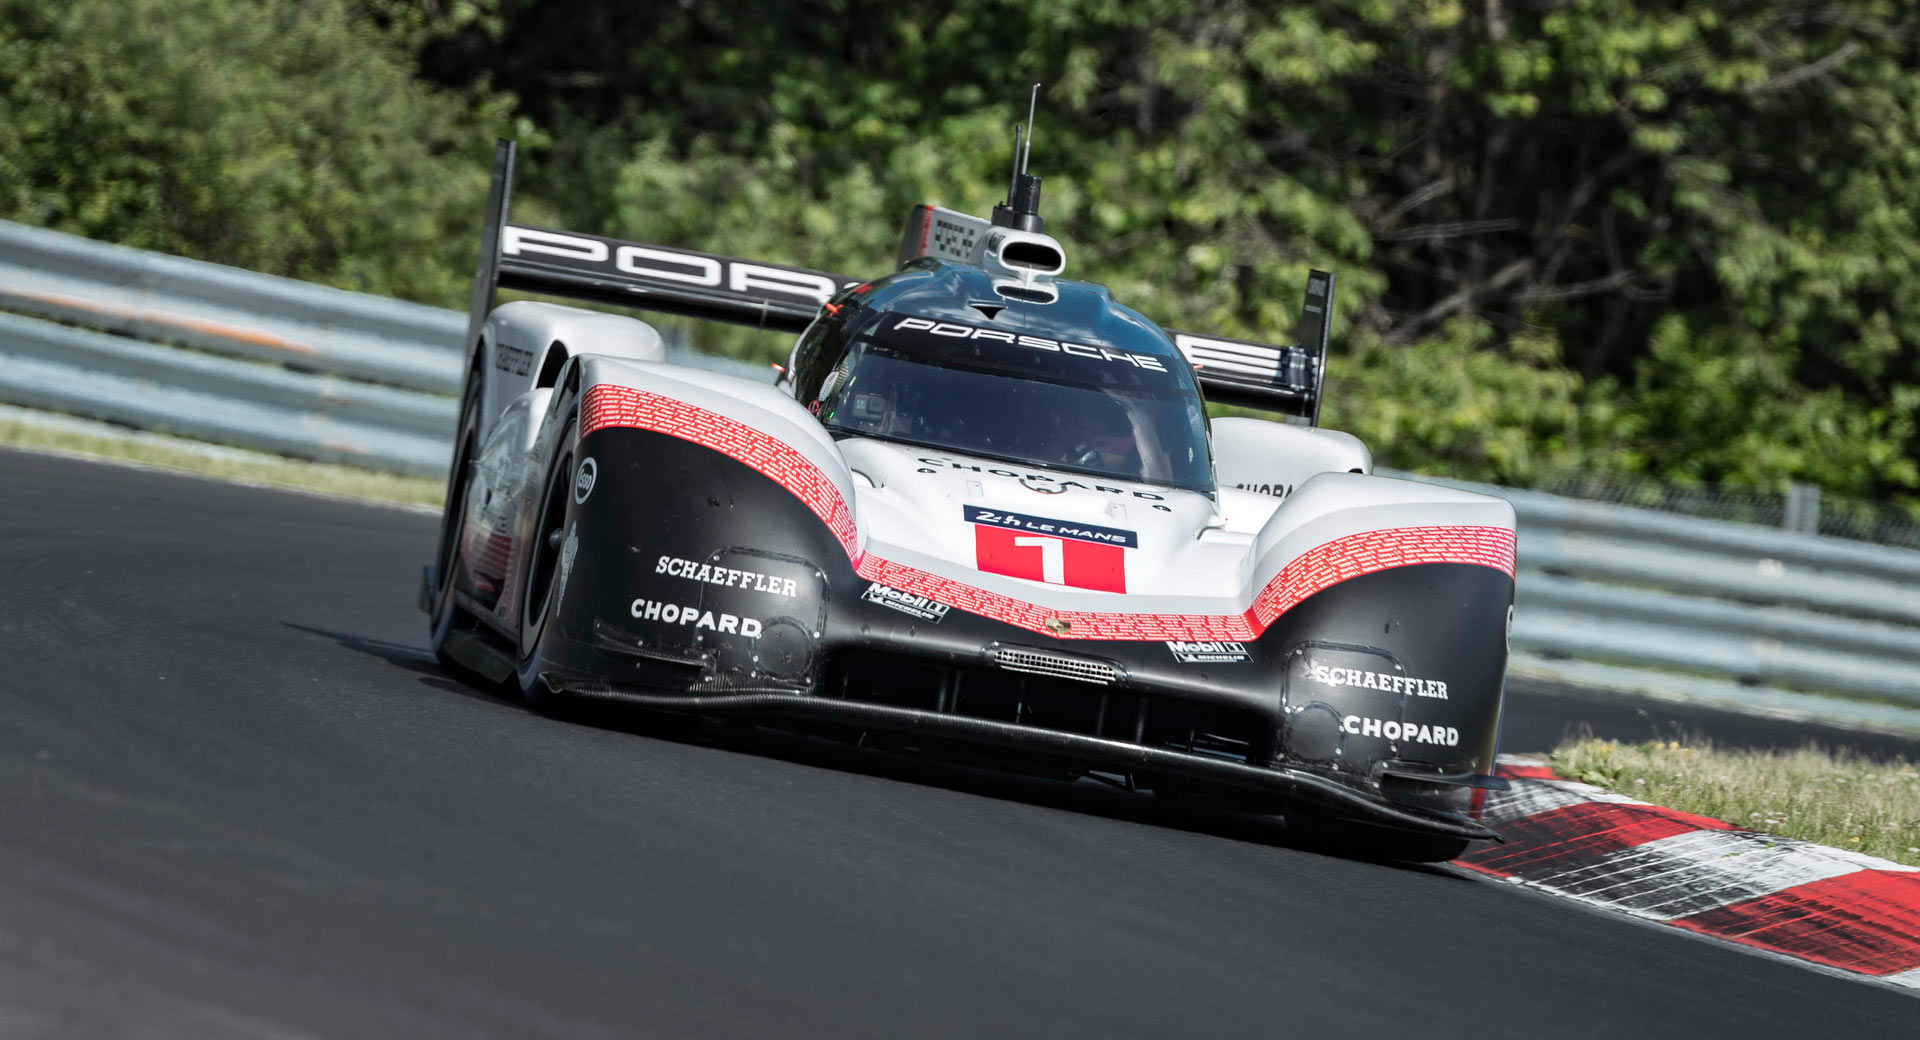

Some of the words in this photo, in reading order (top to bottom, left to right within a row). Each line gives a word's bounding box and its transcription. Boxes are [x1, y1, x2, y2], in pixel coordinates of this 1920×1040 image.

[893, 317, 1168, 373] PORSCHE
[917, 458, 1165, 500] CHOPARD
[1026, 522, 1055, 532] LE
[1059, 527, 1126, 543] MANS
[655, 555, 797, 598] SCHAEFFLER
[1014, 536, 1065, 585] 1
[867, 582, 929, 608] Mobil
[630, 598, 762, 638] CHOPARD
[1165, 641, 1227, 653] Mobil
[1315, 665, 1449, 700] SCHAEFFLER
[1342, 715, 1459, 747] CHOPARD
